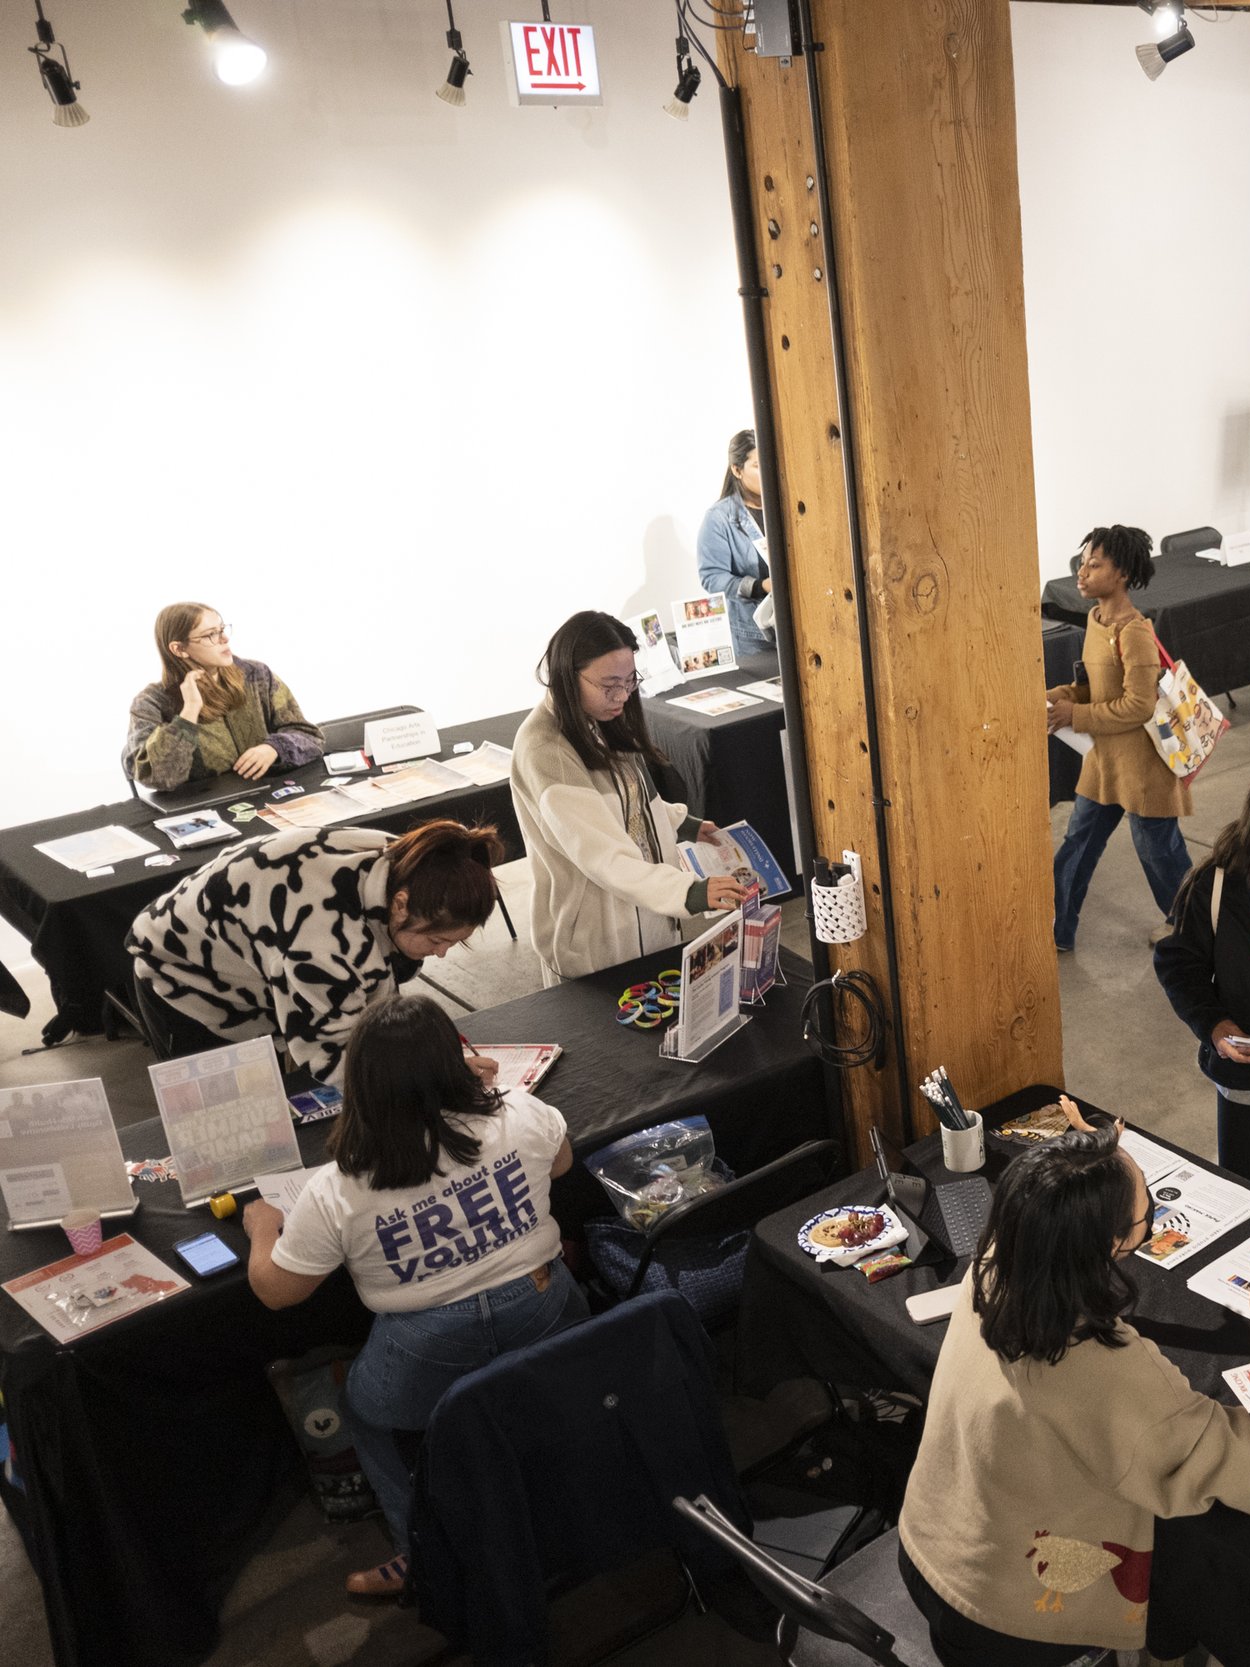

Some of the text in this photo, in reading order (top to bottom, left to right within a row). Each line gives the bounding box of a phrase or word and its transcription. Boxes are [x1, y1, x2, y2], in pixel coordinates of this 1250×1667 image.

[523, 26, 582, 76] EXIT
[375, 1150, 518, 1229] Ask me about our
[376, 1158, 530, 1262] FREE
[388, 1199, 536, 1285] youth
